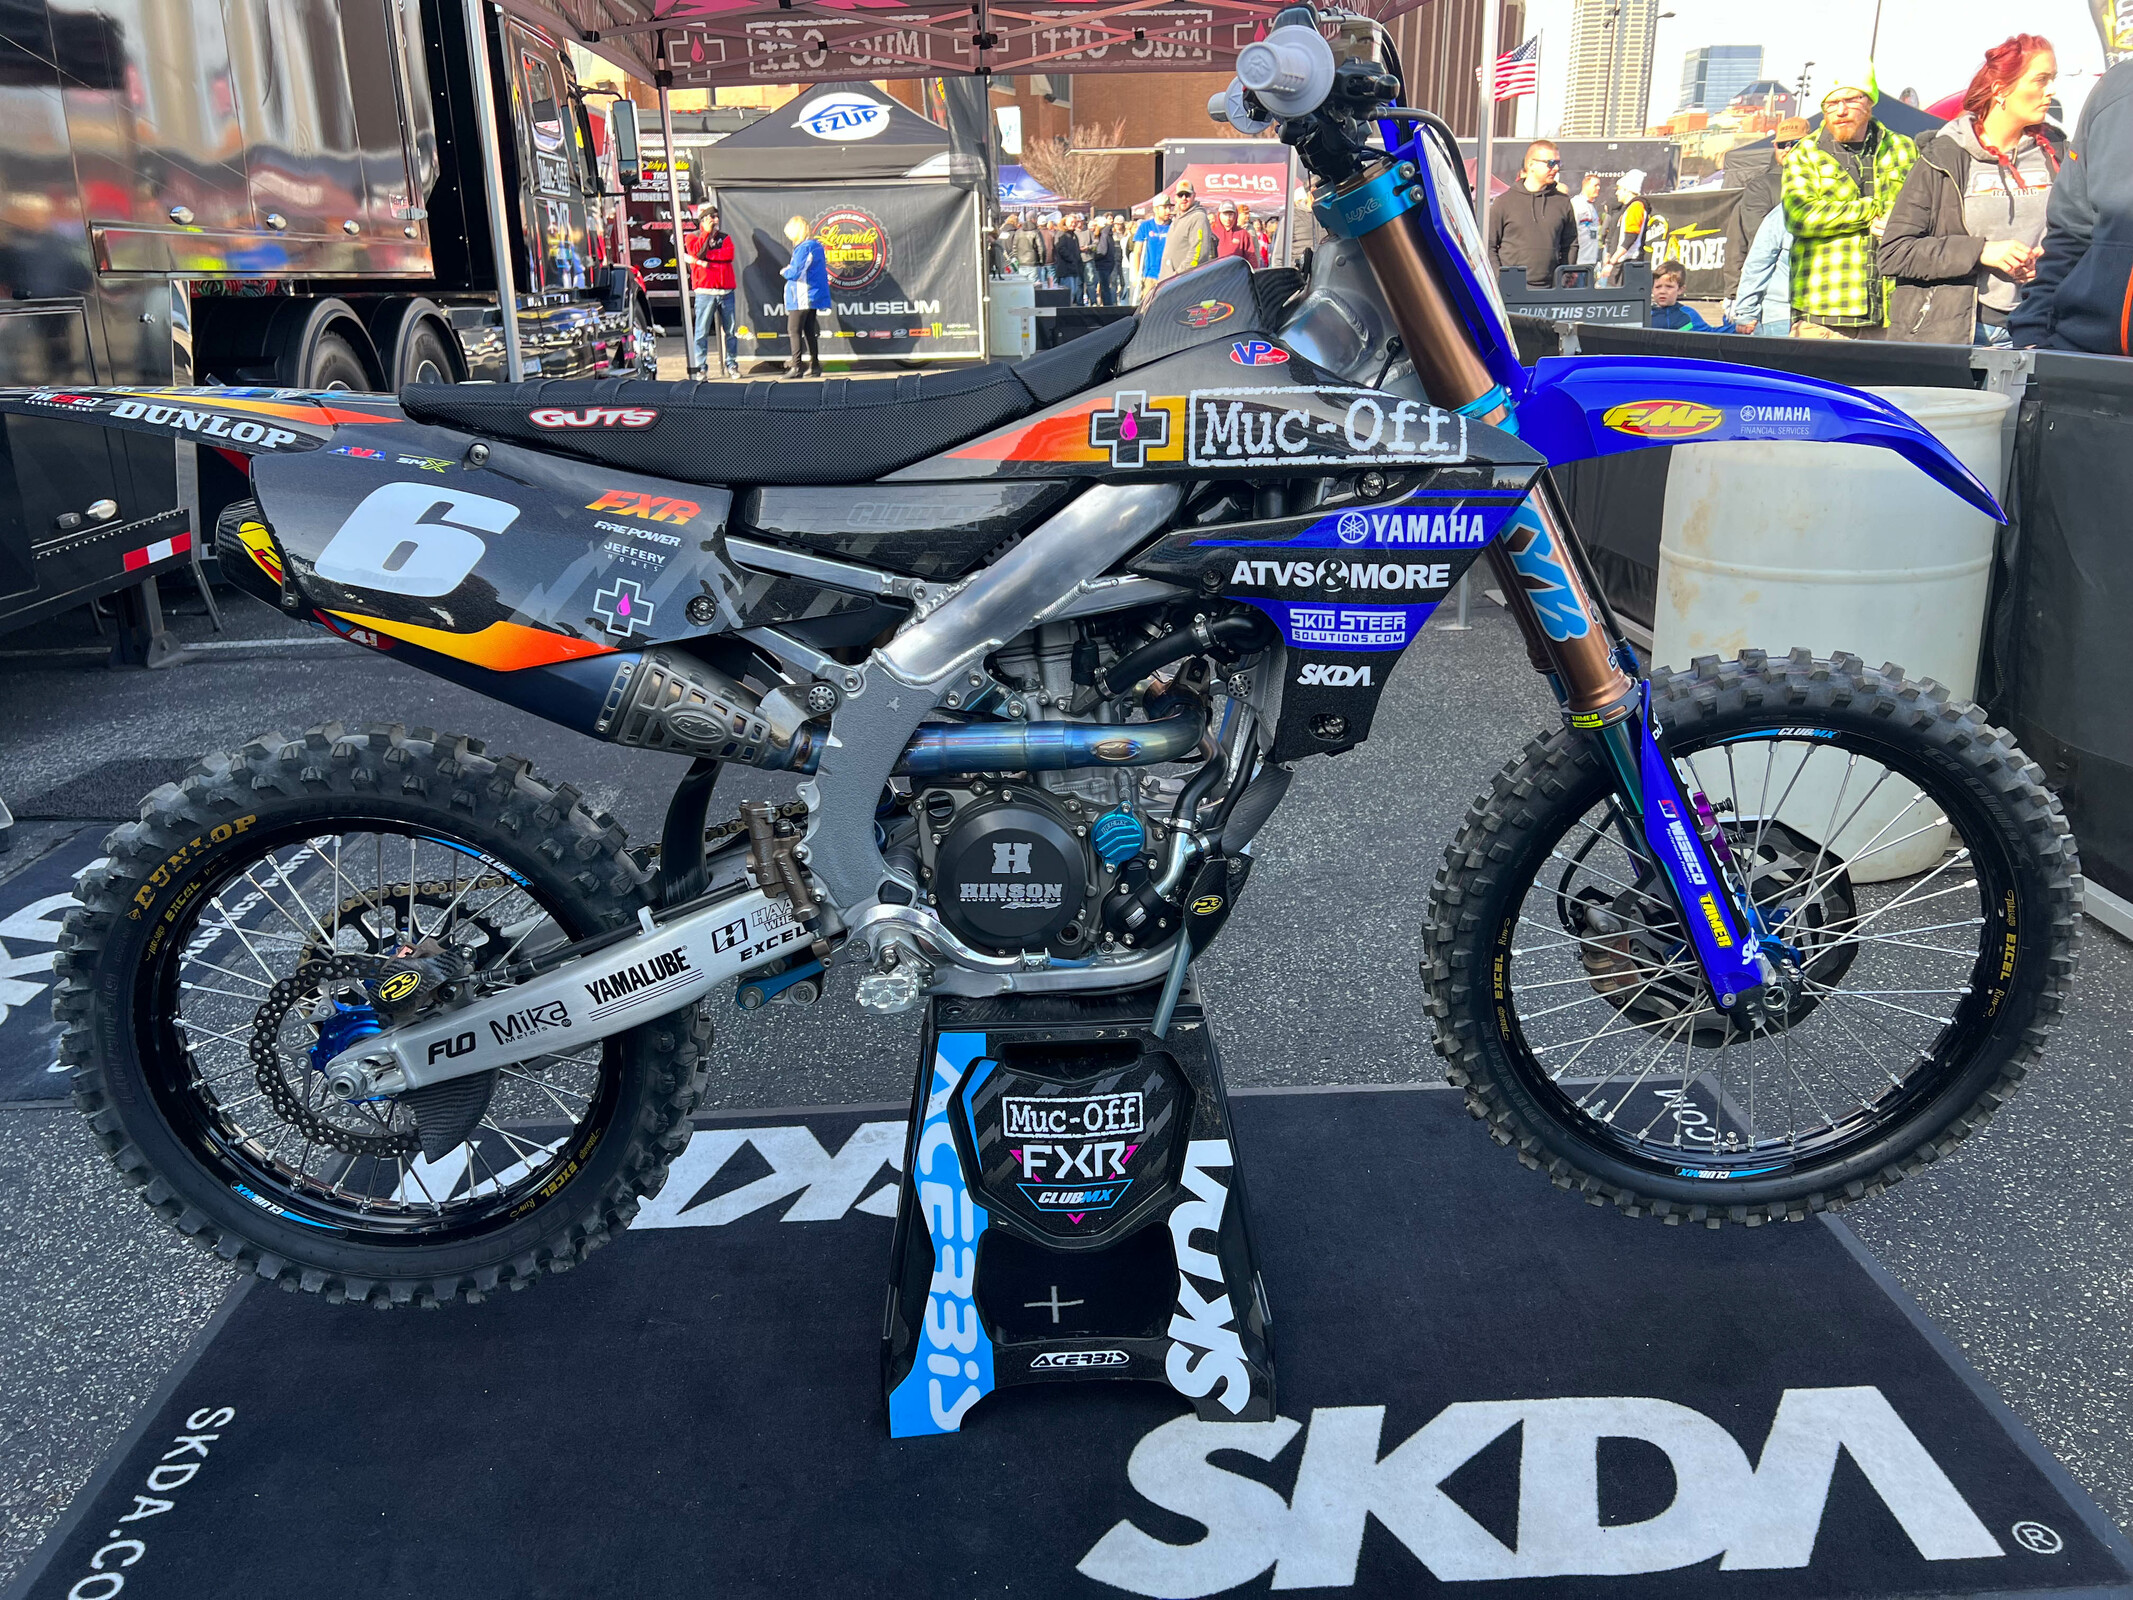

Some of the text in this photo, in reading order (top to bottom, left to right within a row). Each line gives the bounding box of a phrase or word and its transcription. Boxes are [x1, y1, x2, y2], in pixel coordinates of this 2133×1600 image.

[838, 299, 940, 316] MUSEUM
[1552, 306, 1584, 319] THIS
[1586, 304, 1631, 318] STYLE
[1233, 341, 1272, 365] VP
[110, 401, 297, 449] DUNLOP
[531, 408, 657, 428] GUTS
[1201, 397, 1451, 456] Muc-Off
[1603, 405, 1723, 428] FMF
[1740, 425, 1809, 435] FINANCIAL SERVICES
[1756, 406, 1812, 422] YAMAHA
[585, 489, 702, 526] FXR
[314, 481, 521, 599] 6
[1371, 514, 1484, 543] YAMAHA
[604, 541, 666, 565] JEFFERY
[607, 553, 659, 572] HOMES
[1290, 608, 1407, 631] SKID STEER
[1294, 631, 1404, 643] SOLUTIONS.COM
[1297, 664, 1372, 687] SKDA
[1777, 727, 1838, 739] CLUBMX
[133, 814, 257, 911] DUNLOP
[478, 853, 532, 888] CLUBMX
[992, 843, 1032, 874] H
[164, 881, 202, 923] EXCEL
[959, 883, 1063, 898] HINSON
[1699, 892, 1733, 948] TAMER
[738, 926, 807, 962] EXCEL
[1999, 933, 2017, 981] EXCEL
[584, 947, 691, 1006] YAMALUBE
[1493, 953, 1504, 1000] EXCEL
[488, 1000, 569, 1046] Mika
[504, 1026, 548, 1044] Metals
[427, 1031, 476, 1065] FLO
[1009, 1097, 1137, 1133] Muc-Off
[1023, 1140, 1126, 1179] FXR
[1677, 1167, 1731, 1179] CLUBMX
[540, 1160, 579, 1198] EXCEL
[233, 1183, 286, 1215] CLUBMX
[1037, 1188, 1115, 1204] CLUBMX
[917, 1051, 984, 1432] ACERBIS
[1164, 1139, 1251, 1417] SKDA
[1031, 1351, 1128, 1367] ACERBIS
[1075, 1384, 2008, 1600] SKDA
